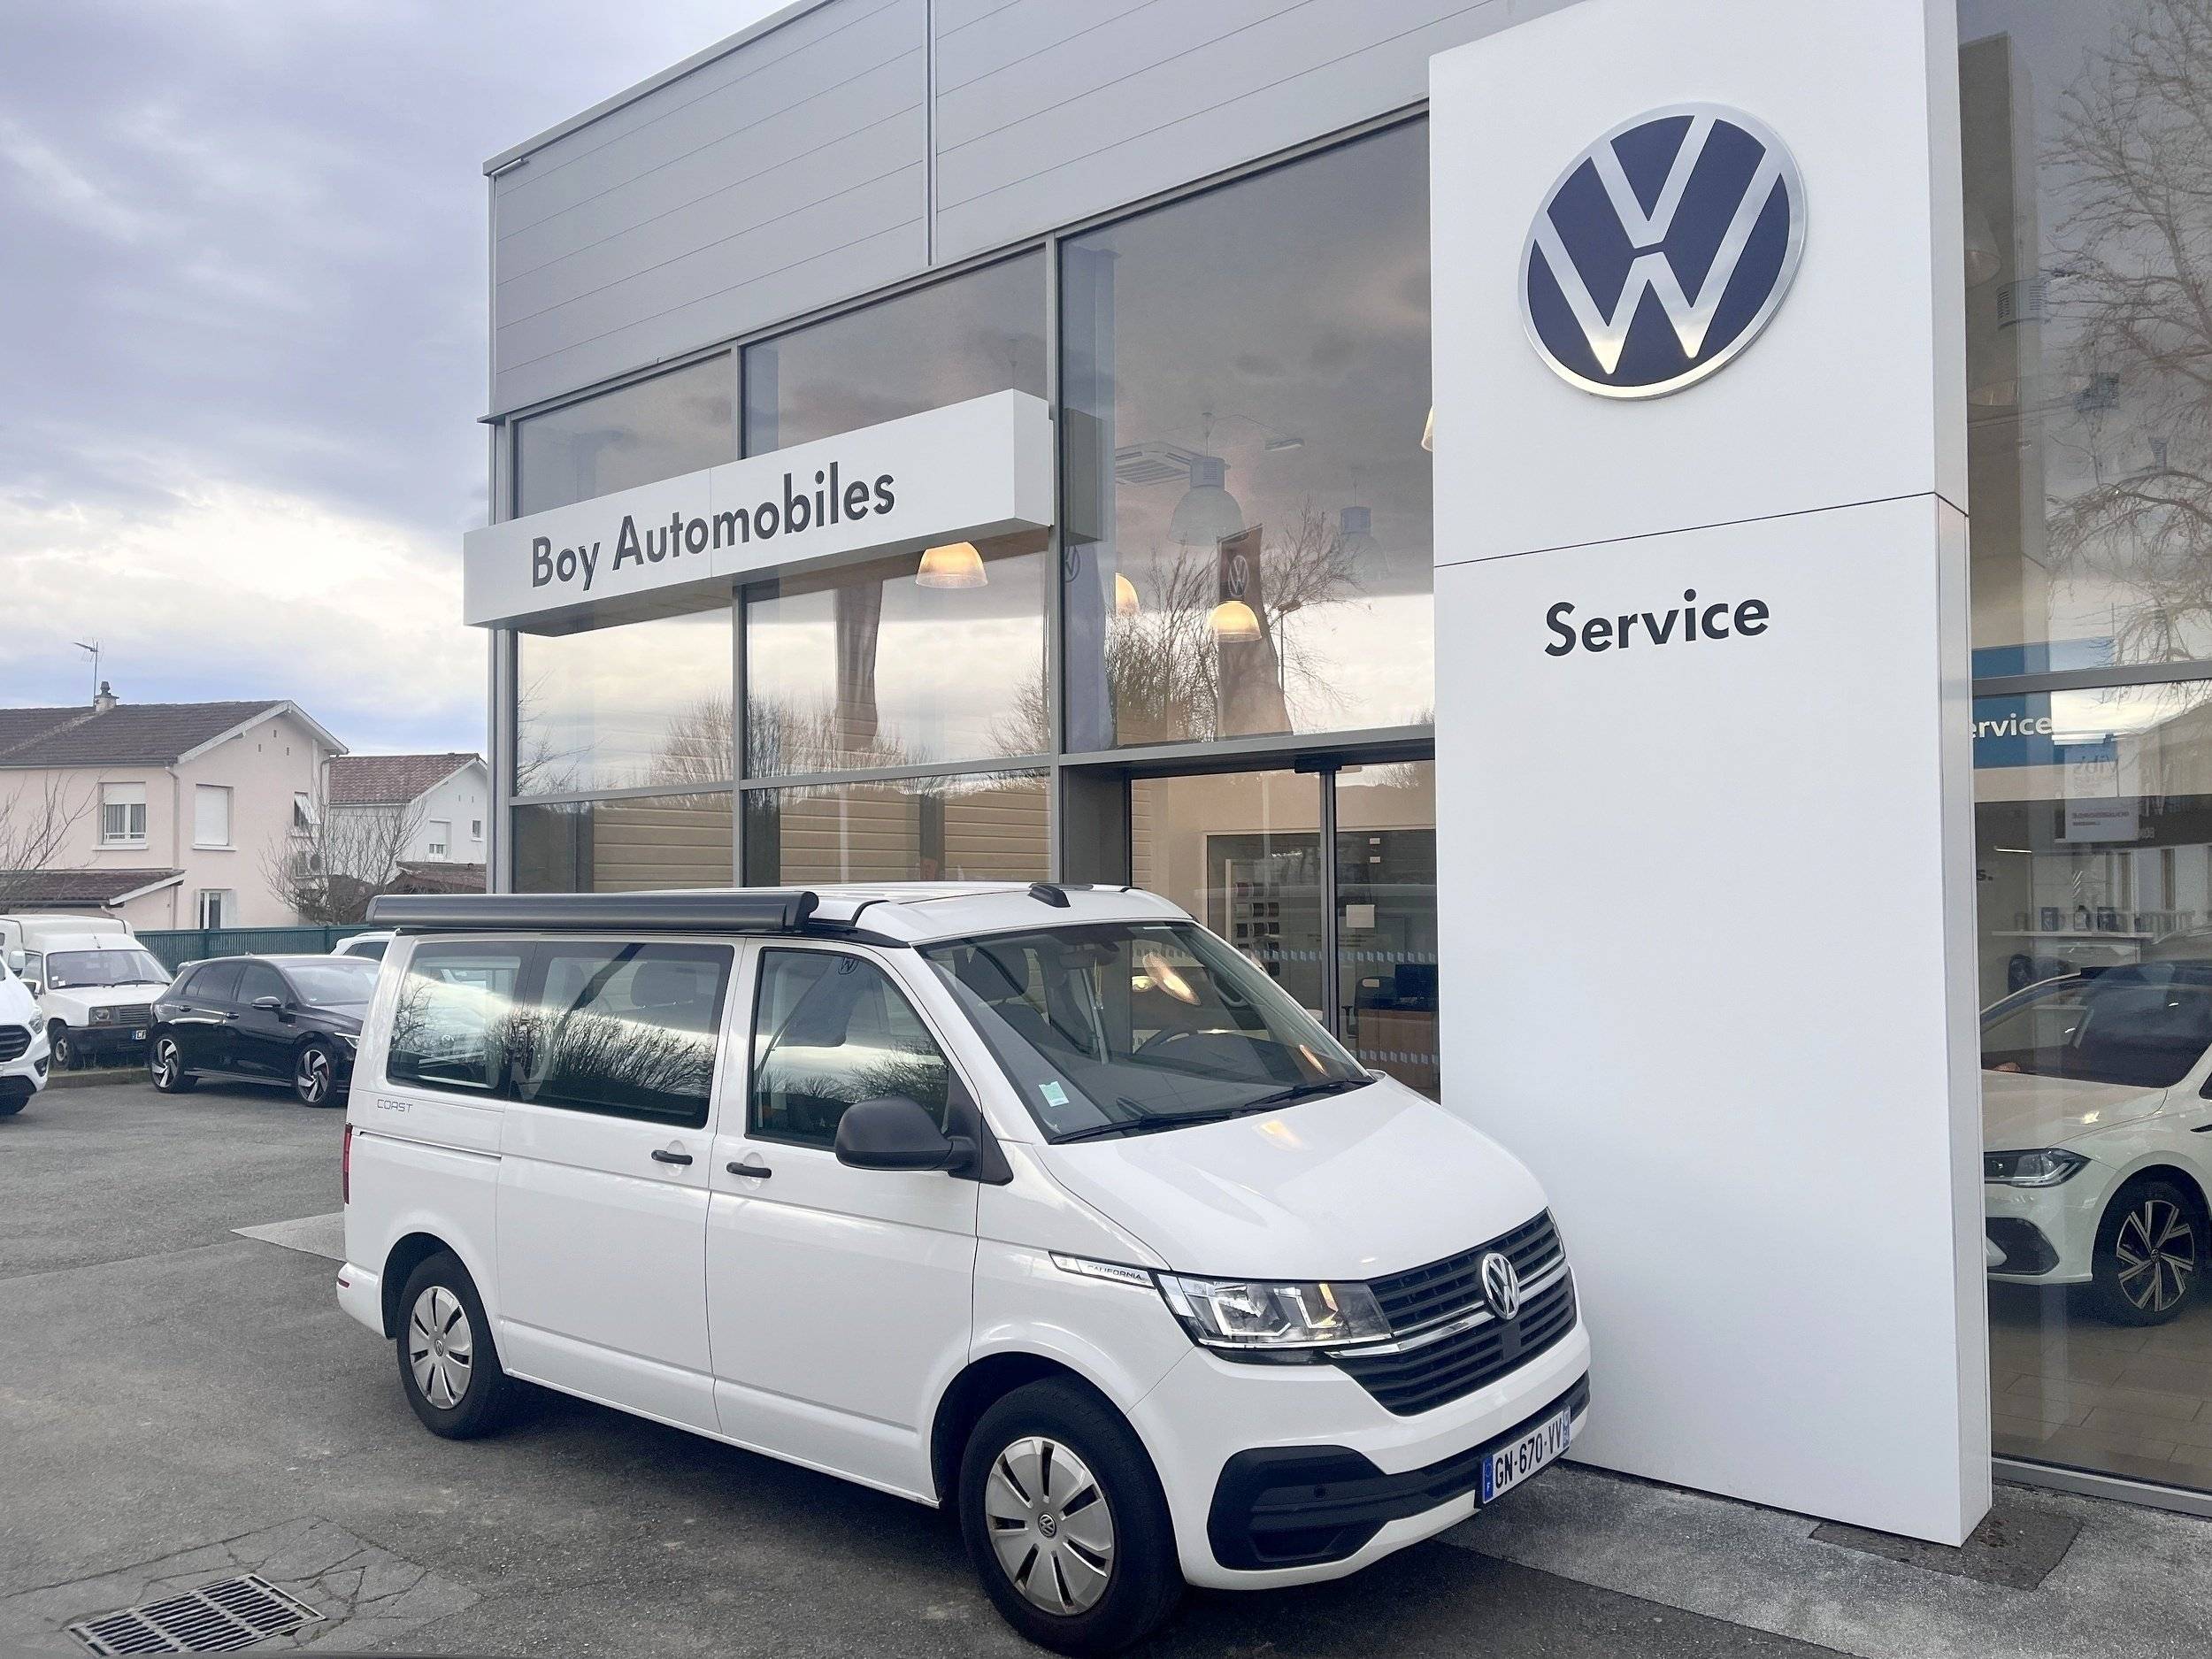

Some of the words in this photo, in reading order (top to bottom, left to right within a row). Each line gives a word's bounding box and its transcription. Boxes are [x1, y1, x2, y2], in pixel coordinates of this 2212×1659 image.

[1519, 104, 1806, 398] VW
[532, 536, 600, 590] Boy
[612, 461, 895, 571] Automobiles
[1544, 588, 1770, 657] Service
[377, 1099, 413, 1113] COAST
